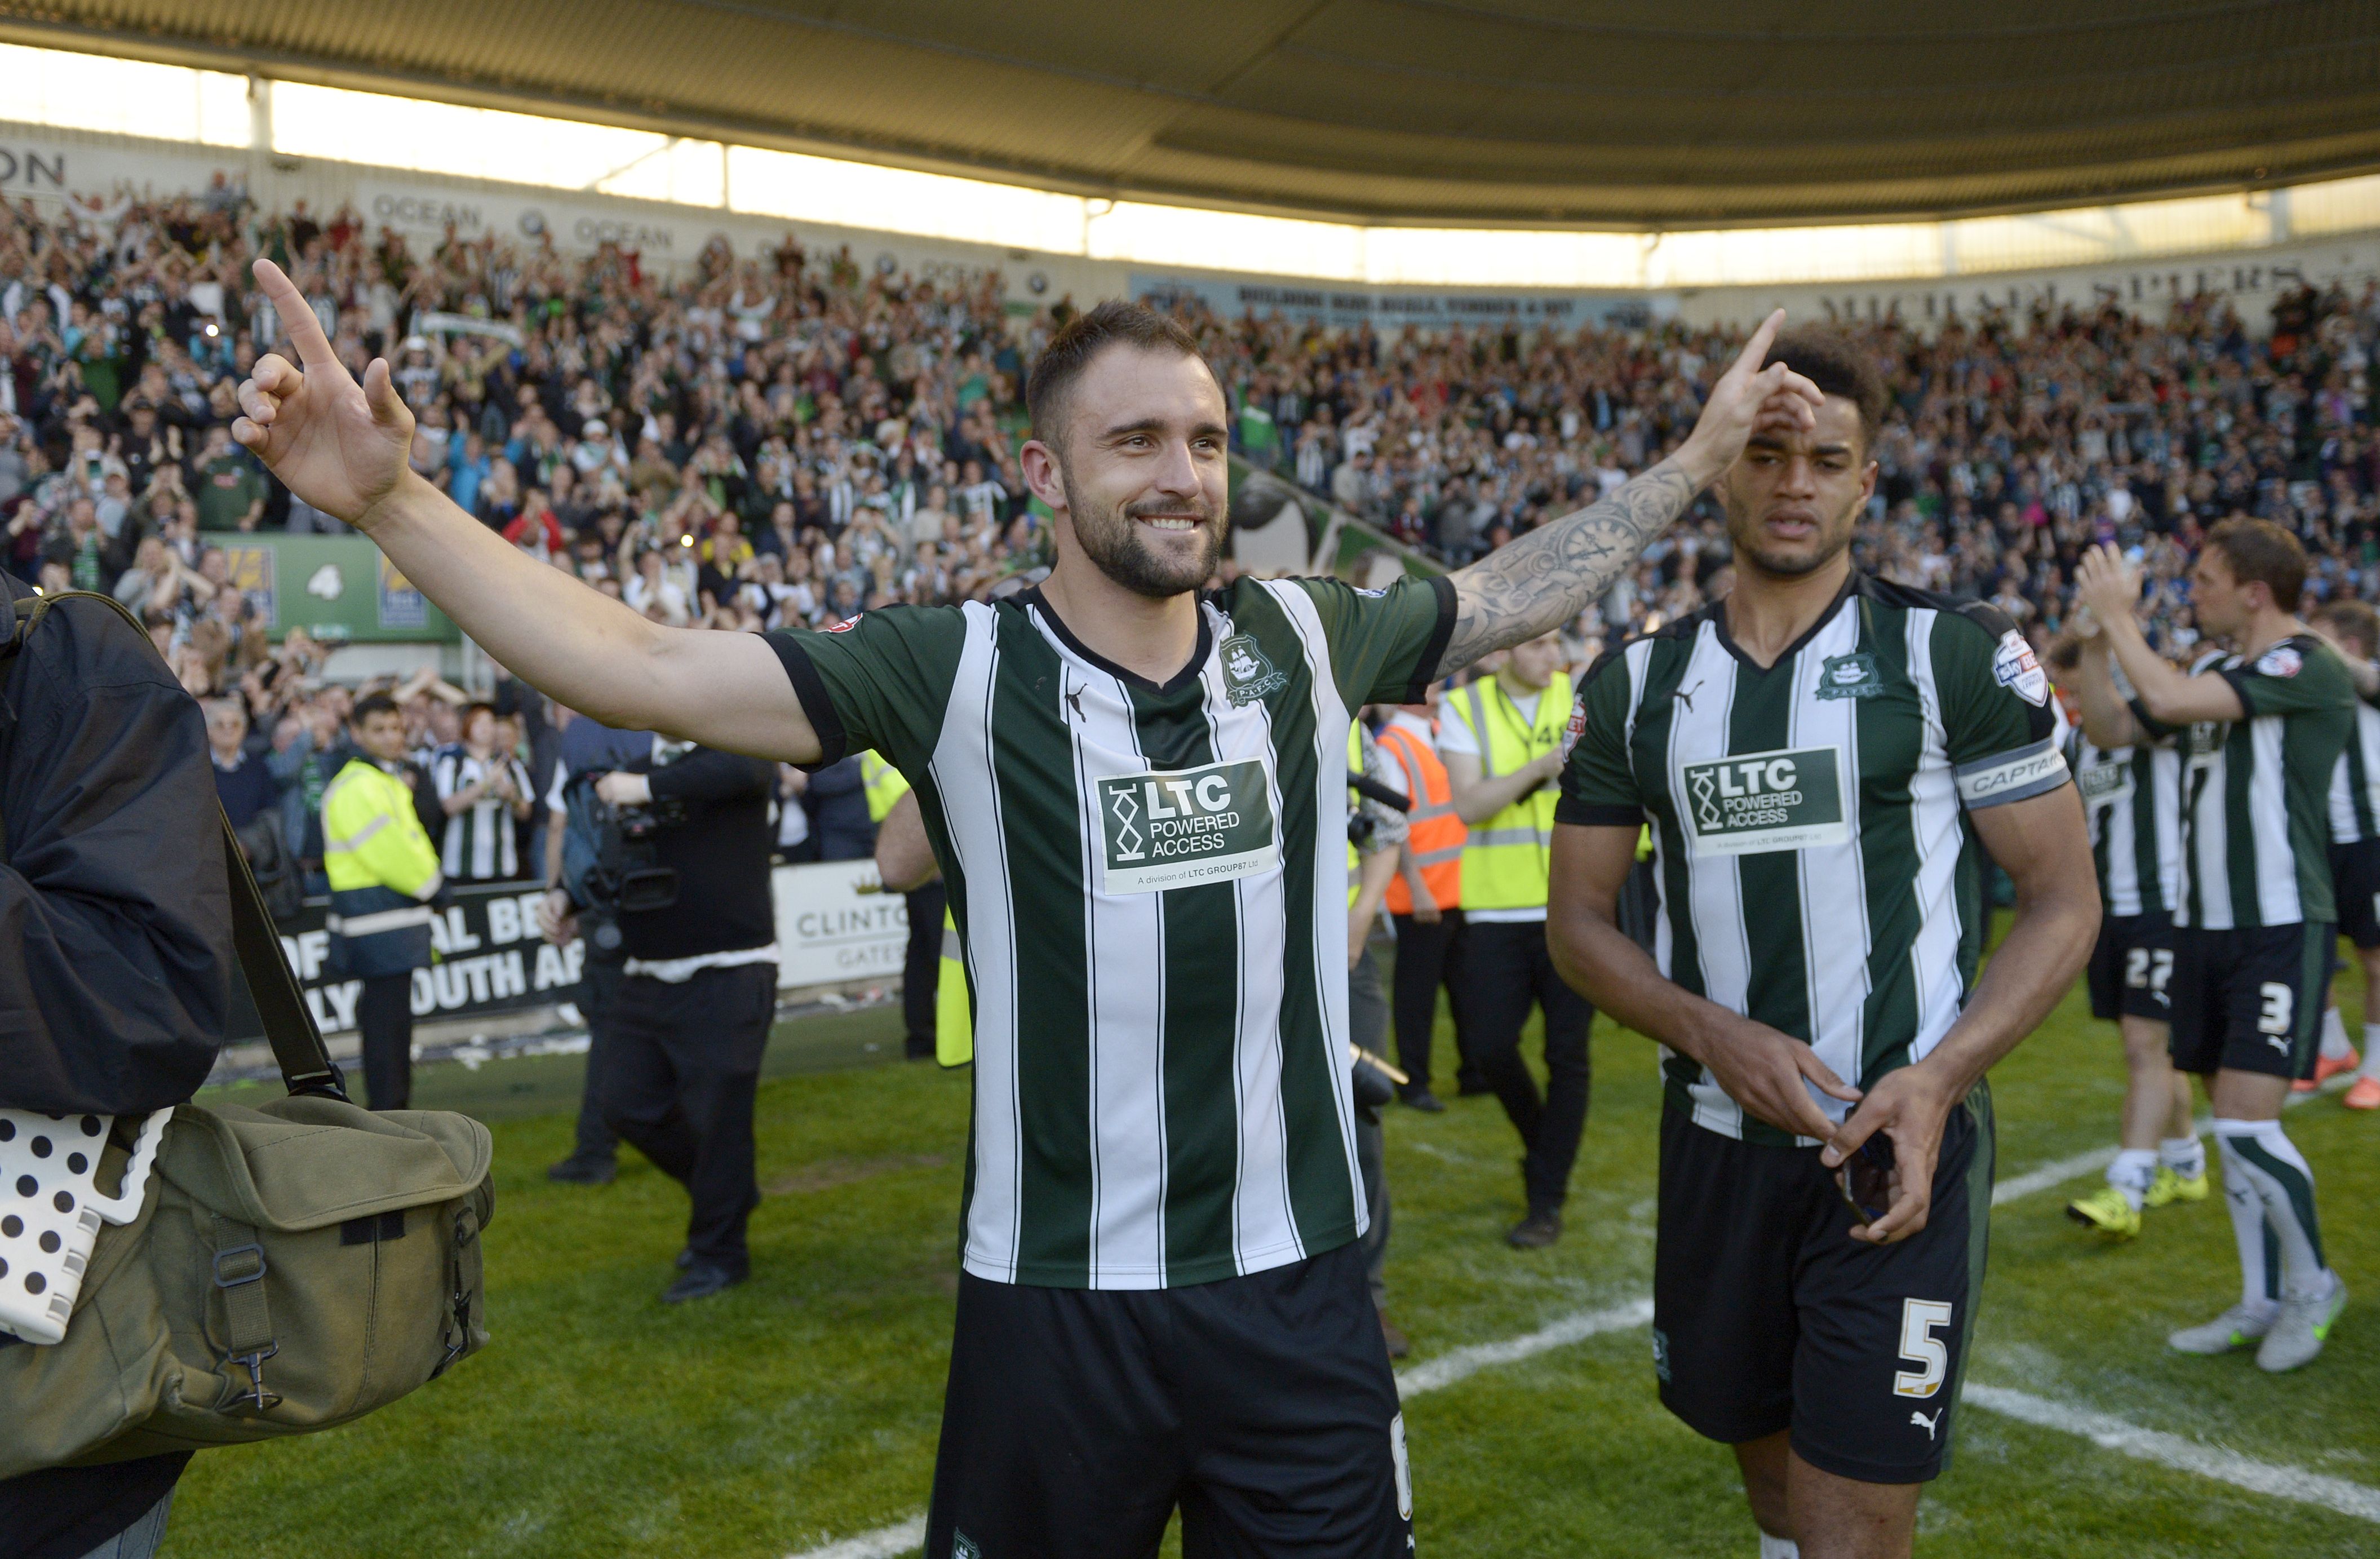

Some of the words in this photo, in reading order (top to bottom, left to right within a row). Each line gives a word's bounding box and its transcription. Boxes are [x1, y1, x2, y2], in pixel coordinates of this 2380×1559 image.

[372, 194, 482, 228] OCEAN
[1719, 758, 1797, 798] LTC
[1974, 752, 2058, 792] CAPTAI
[1145, 774, 1231, 820] LTC
[1722, 790, 1803, 813] POWERED
[1150, 812, 1240, 839] POWERED
[1726, 808, 1788, 828] ACCESS
[1152, 832, 1225, 858] ACCESS
[1146, 874, 1177, 884] division
[1179, 871, 1186, 879] of
[1189, 869, 1204, 878] LTC
[1207, 862, 1247, 875] GROUP87
[1248, 859, 1258, 868] Ltd
[2125, 947, 2174, 991] 27
[2258, 981, 2293, 1035] 3
[1893, 1297, 1952, 1399] 5
